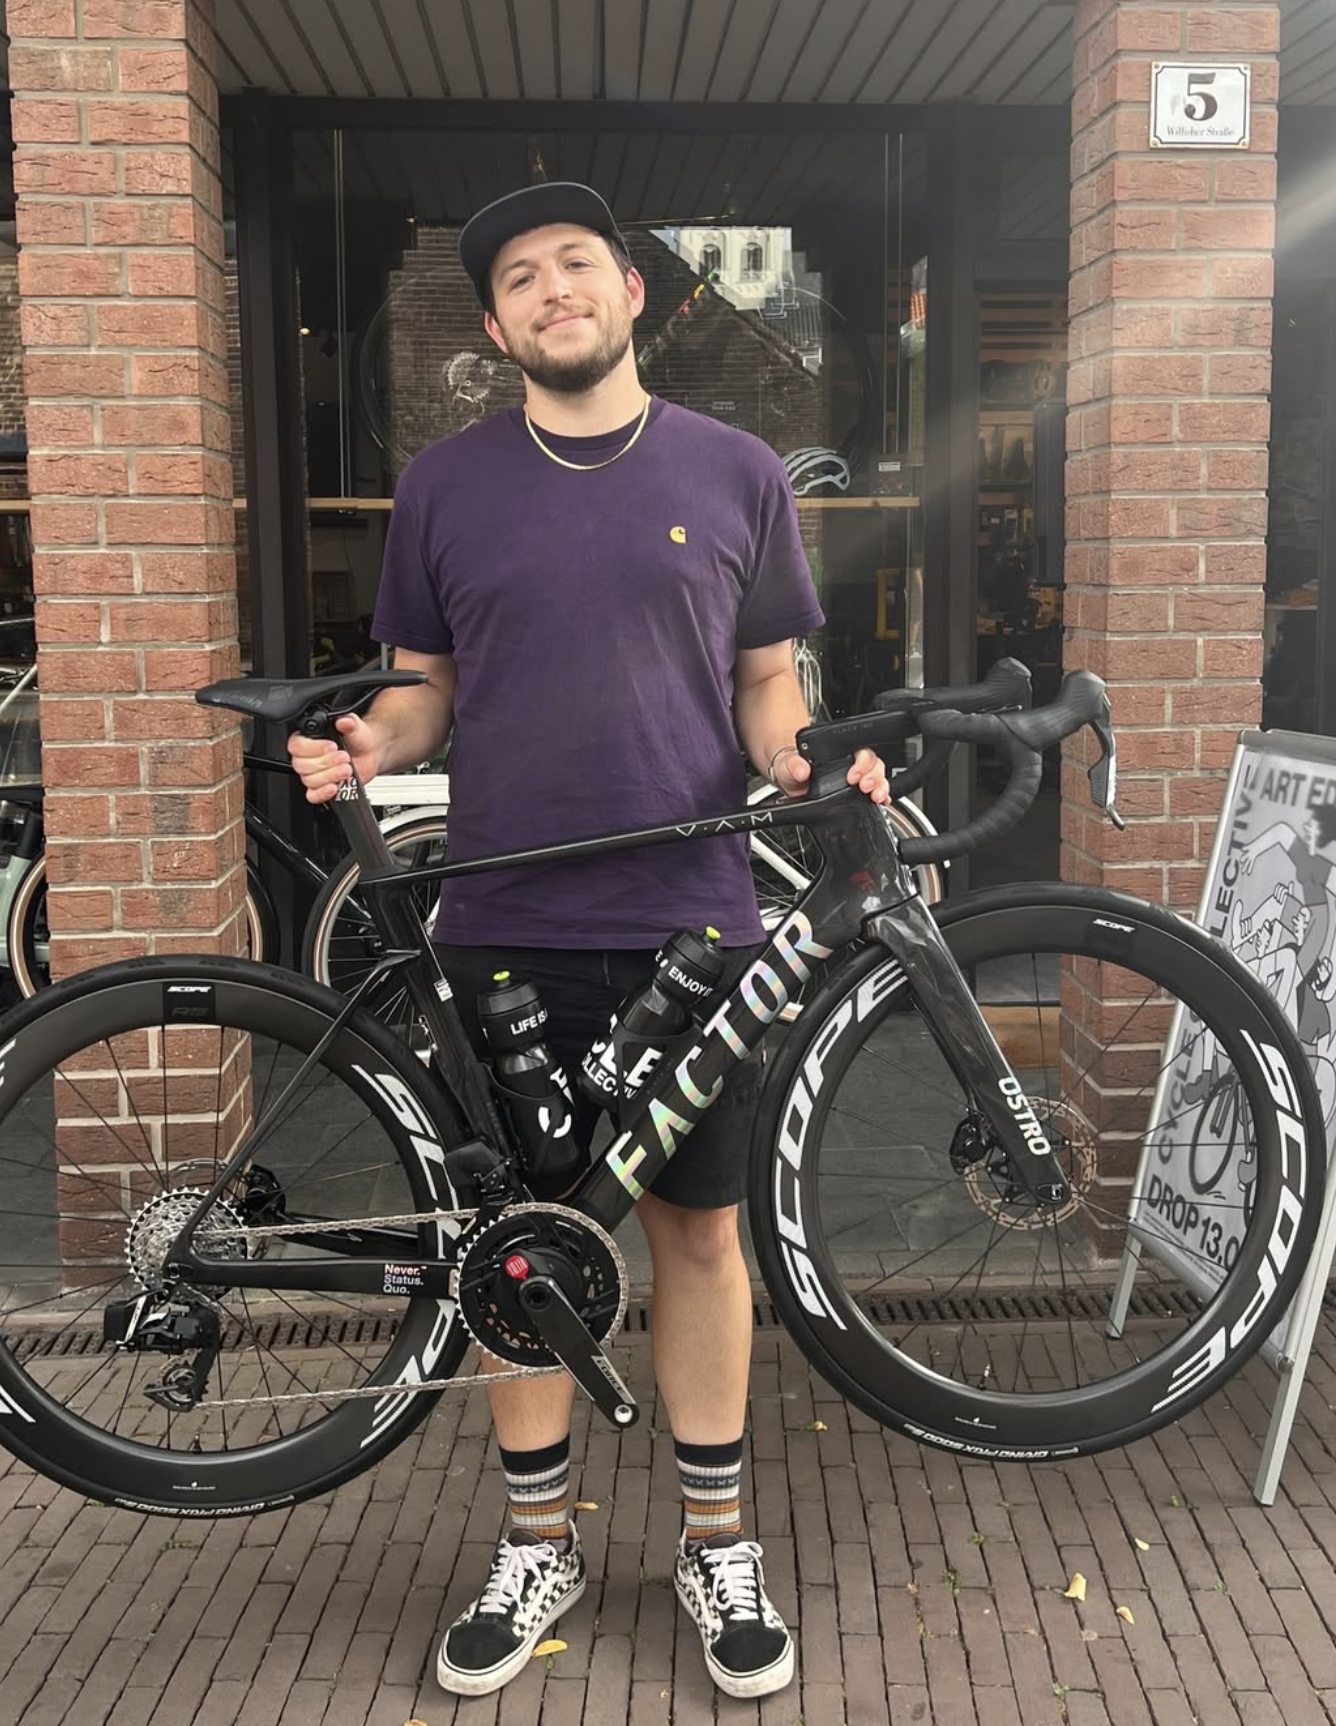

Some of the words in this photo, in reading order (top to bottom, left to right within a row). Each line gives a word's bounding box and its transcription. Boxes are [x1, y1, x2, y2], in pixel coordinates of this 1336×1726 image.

[1184, 72, 1218, 121] 5
[1206, 127, 1235, 137] Straße
[1260, 767, 1306, 807] ART
[668, 965, 707, 995] ENJOY
[510, 1015, 538, 1035] LIFE
[605, 910, 834, 1201] FACTOR
[998, 1076, 1051, 1156] OSTRO
[1158, 1028, 1194, 1165] CYCLE
[775, 959, 908, 1331] SCOPE
[1147, 1174, 1200, 1236] DROP
[1150, 1029, 1303, 1413] SCOPE
[382, 1284, 410, 1295] Quo.
[383, 1274, 424, 1286] Status.
